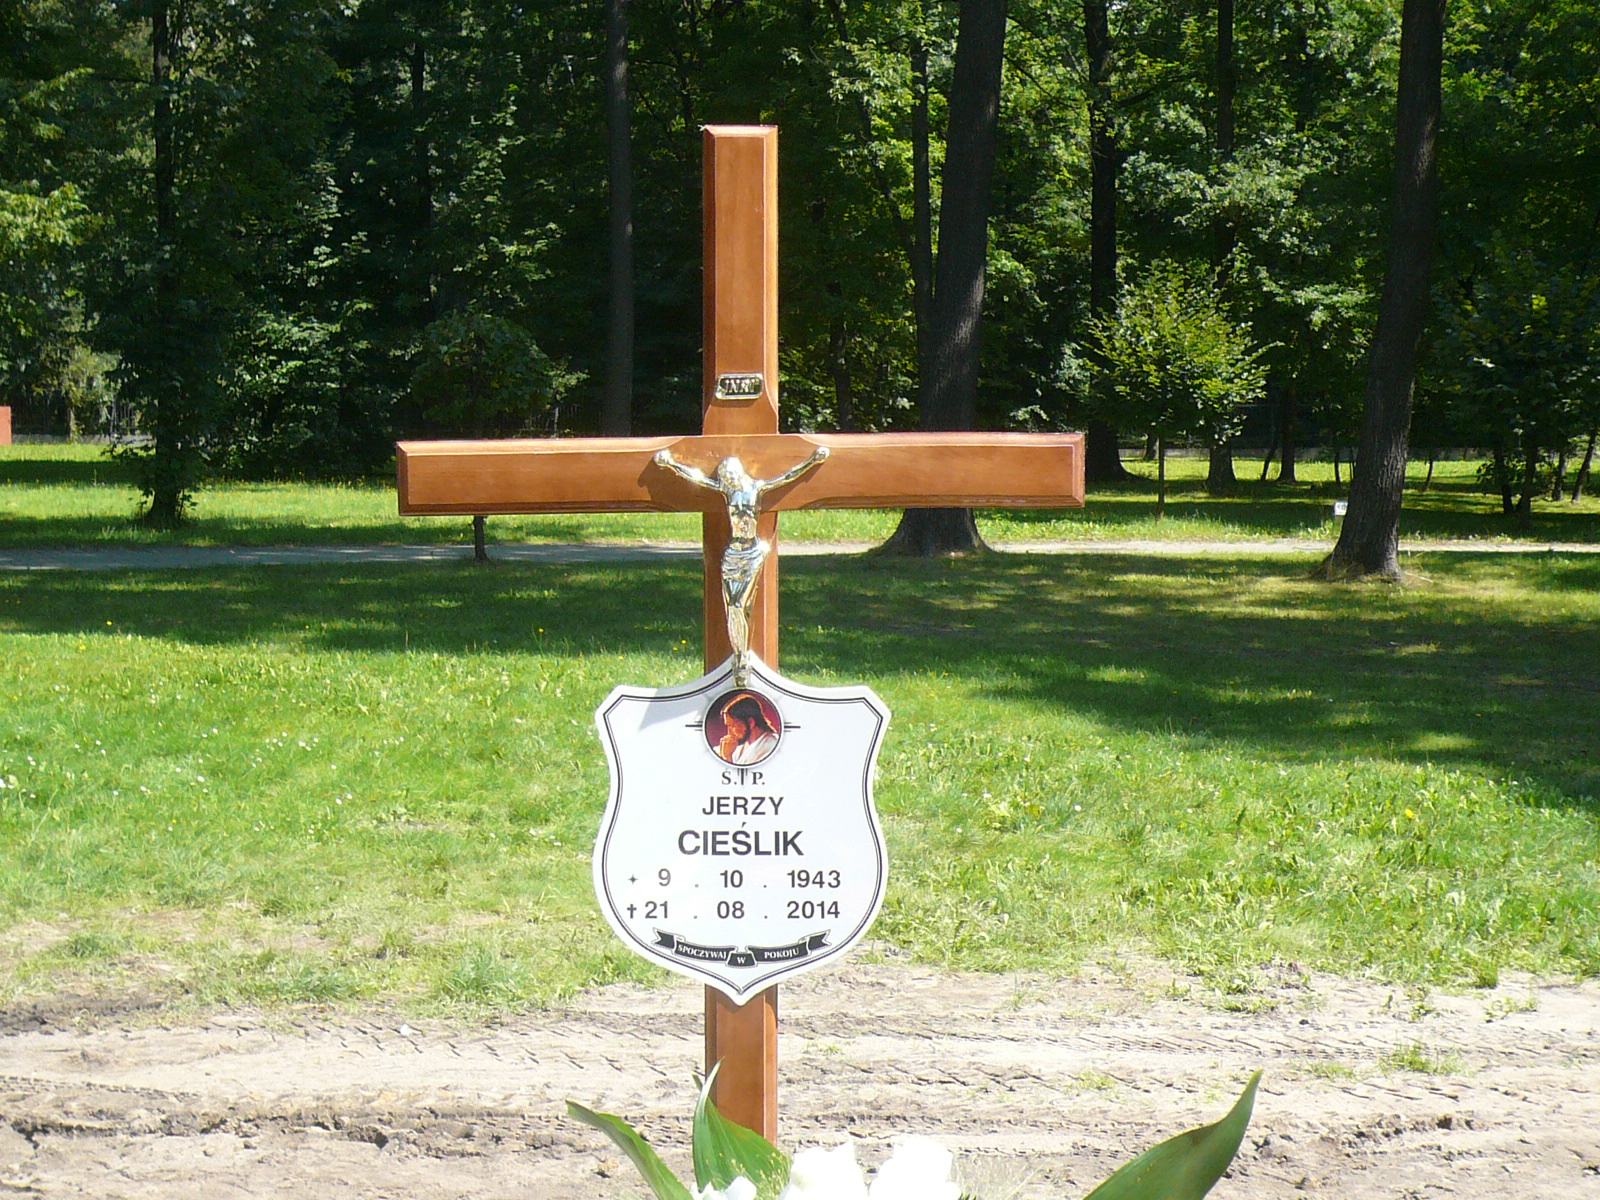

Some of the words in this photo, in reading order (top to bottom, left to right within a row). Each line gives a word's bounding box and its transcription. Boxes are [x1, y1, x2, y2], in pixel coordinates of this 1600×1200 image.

[725, 379, 755, 393] INRI
[752, 772, 765, 785] P.
[702, 796, 784, 816] JERZY
[678, 821, 804, 856] CIEŚLIK
[658, 868, 671, 887] 9
[720, 869, 743, 889] 10
[787, 869, 841, 889] 1943
[644, 901, 669, 919] 21
[717, 901, 745, 919] 08
[787, 900, 840, 919] 2014
[678, 944, 726, 959] SPOCZYWAJ
[736, 956, 746, 964] W
[764, 947, 799, 959] POKOJU
